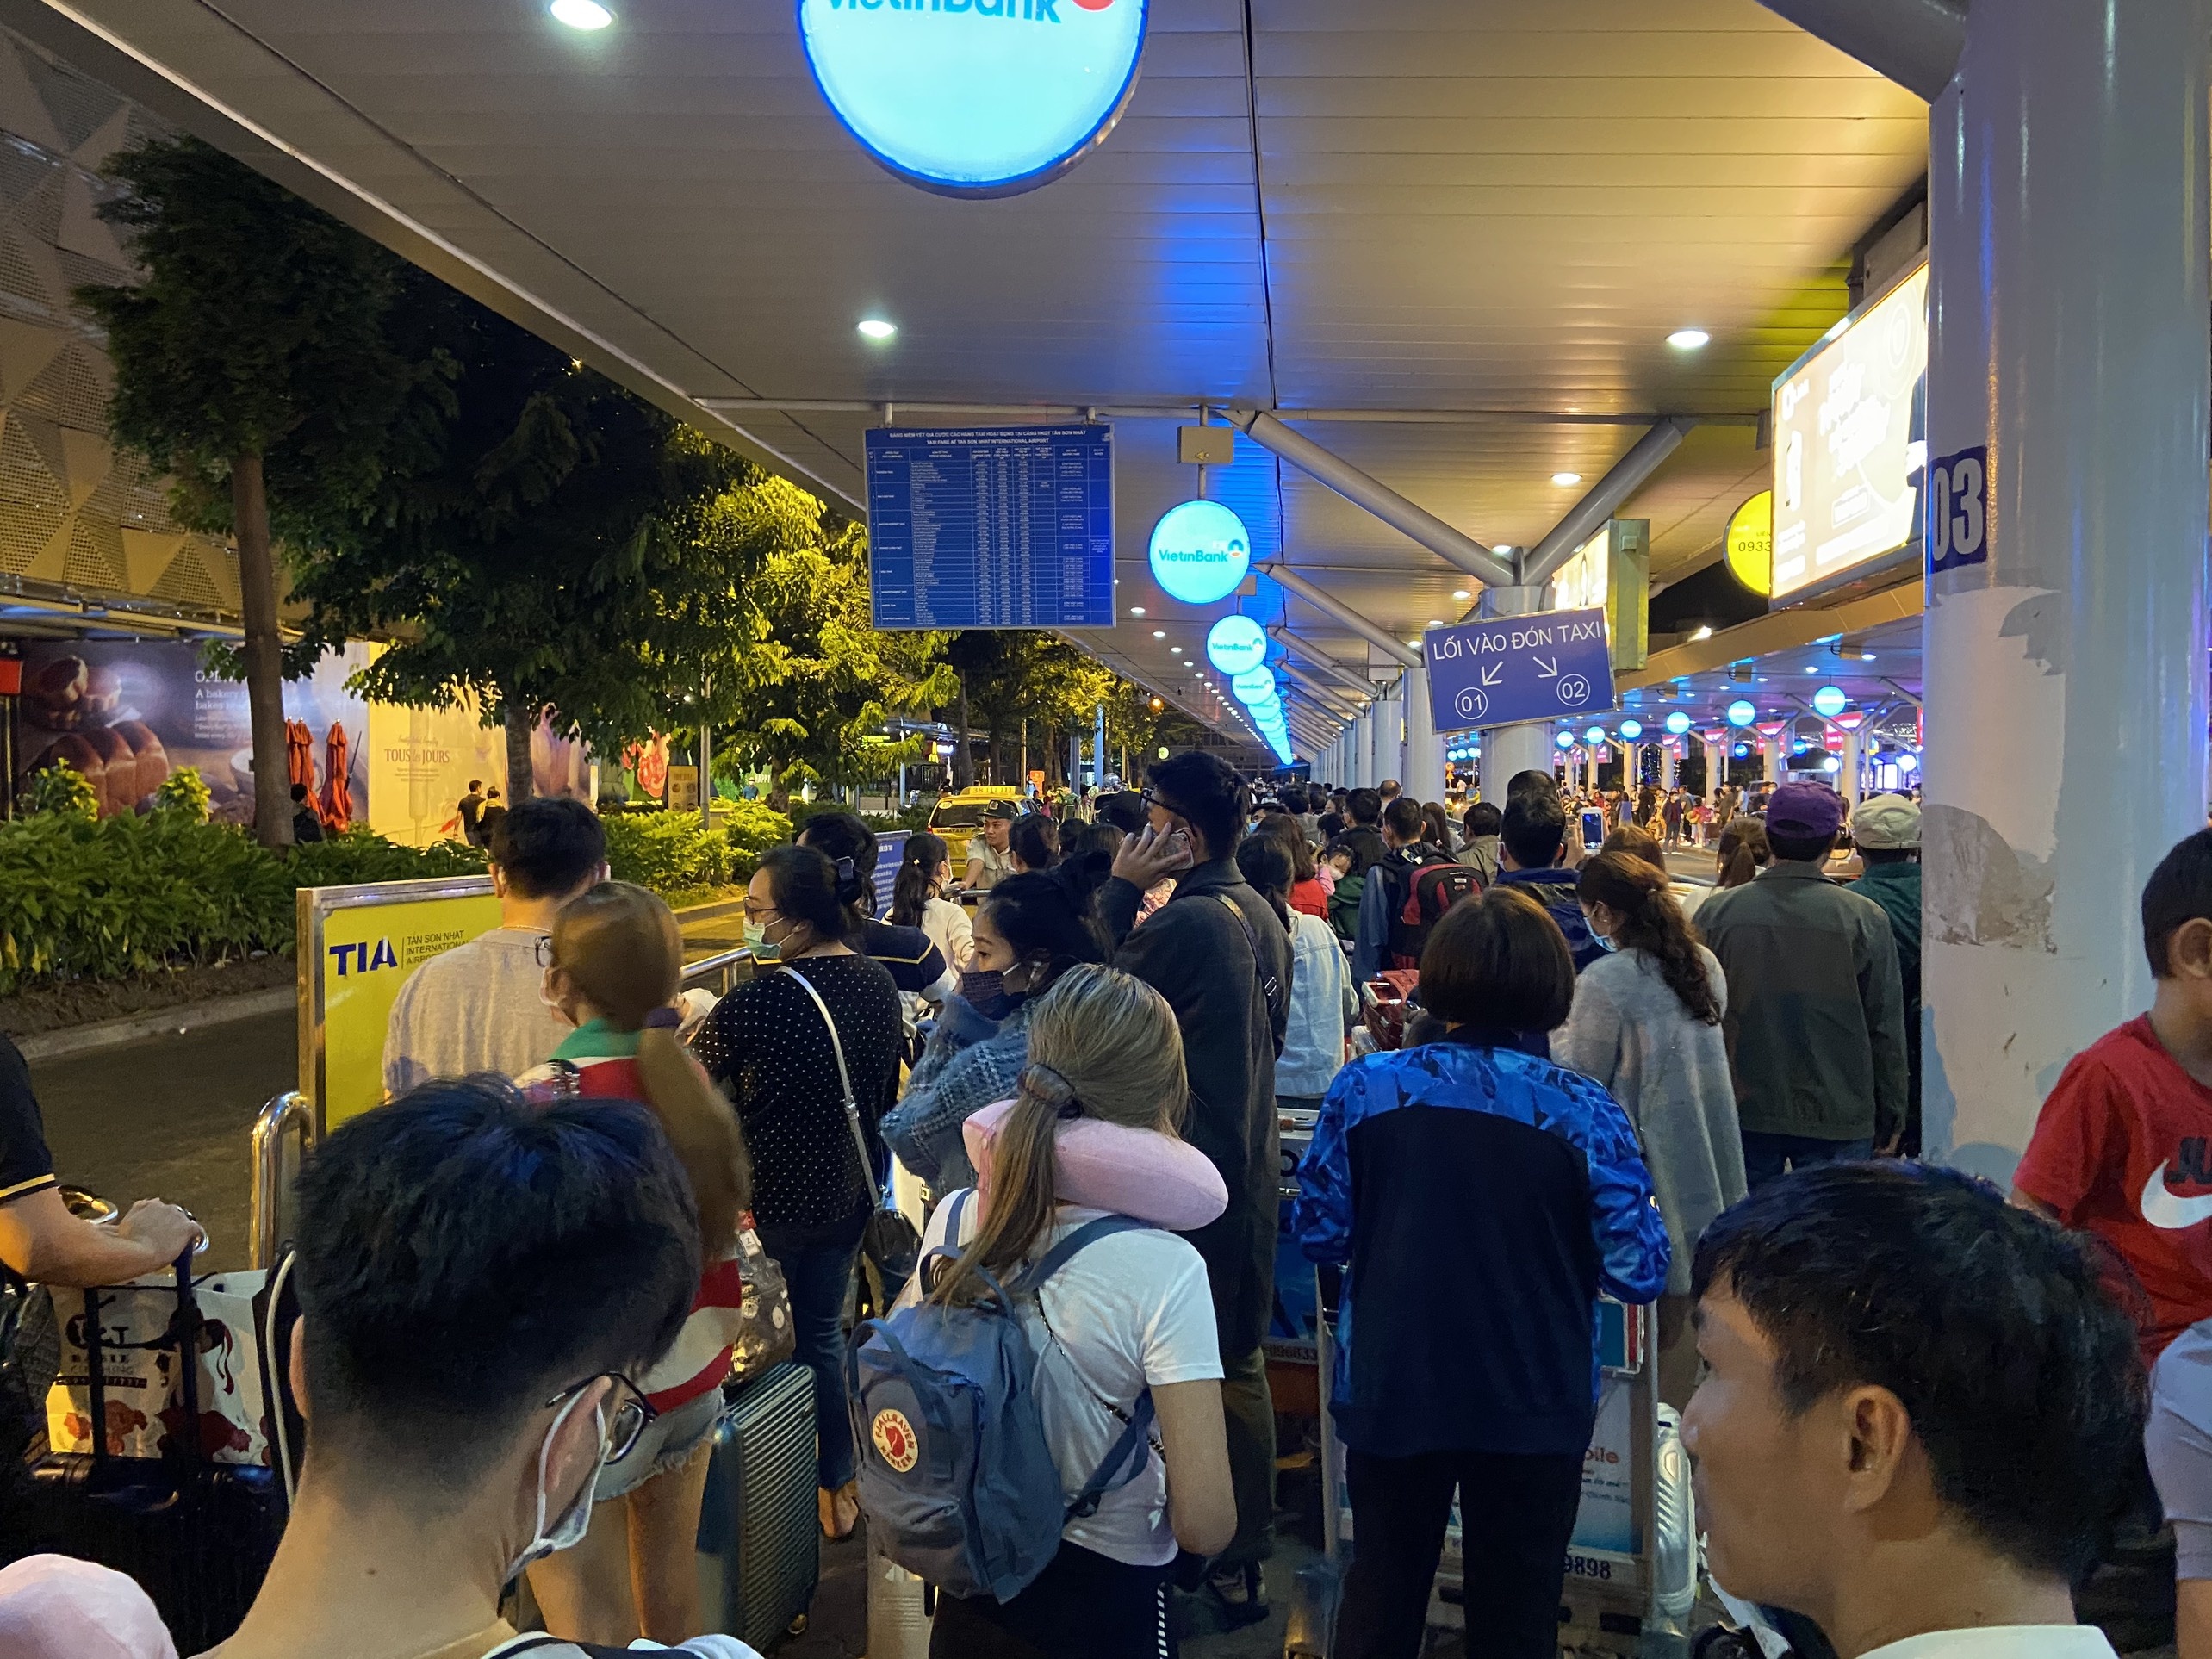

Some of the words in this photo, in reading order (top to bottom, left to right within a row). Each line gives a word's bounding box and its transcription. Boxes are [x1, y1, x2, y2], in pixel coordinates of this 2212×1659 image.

[1933, 457, 1984, 561] 03
[1159, 549, 1228, 562] VietinBank
[1433, 635, 1463, 660] LỐI
[1466, 632, 1507, 656] VÀO
[1511, 625, 1553, 649] ĐÓN
[1557, 621, 1601, 643] TAXI
[1562, 680, 1586, 699] 02
[1461, 693, 1482, 712] 01
[384, 749, 410, 762] TOUS
[422, 749, 450, 765] JOURS
[425, 933, 441, 943] SON
[444, 930, 465, 941] NHAT
[329, 936, 398, 976] TIA
[406, 940, 469, 955] INTERNATIONA
